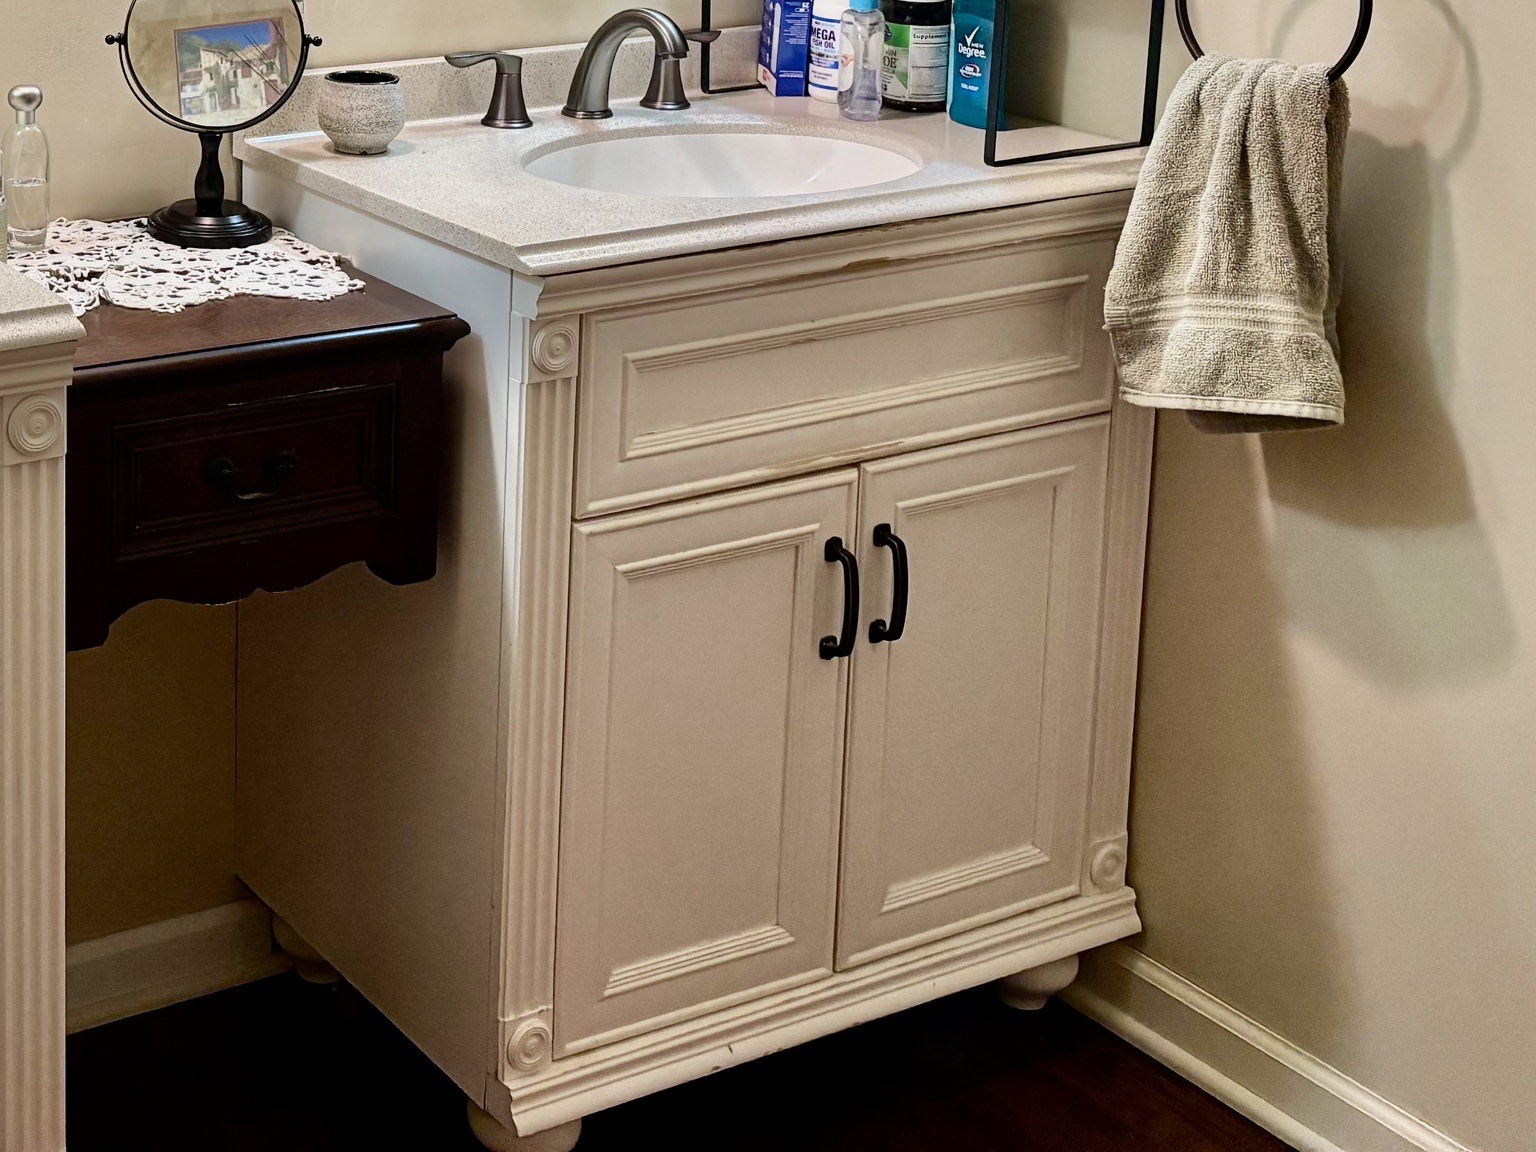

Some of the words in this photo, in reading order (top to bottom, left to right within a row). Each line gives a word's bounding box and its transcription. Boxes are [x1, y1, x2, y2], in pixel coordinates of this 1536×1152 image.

[811, 26, 836, 42] MEGA
[824, 41, 835, 50] OIL
[958, 42, 986, 59] Degree
